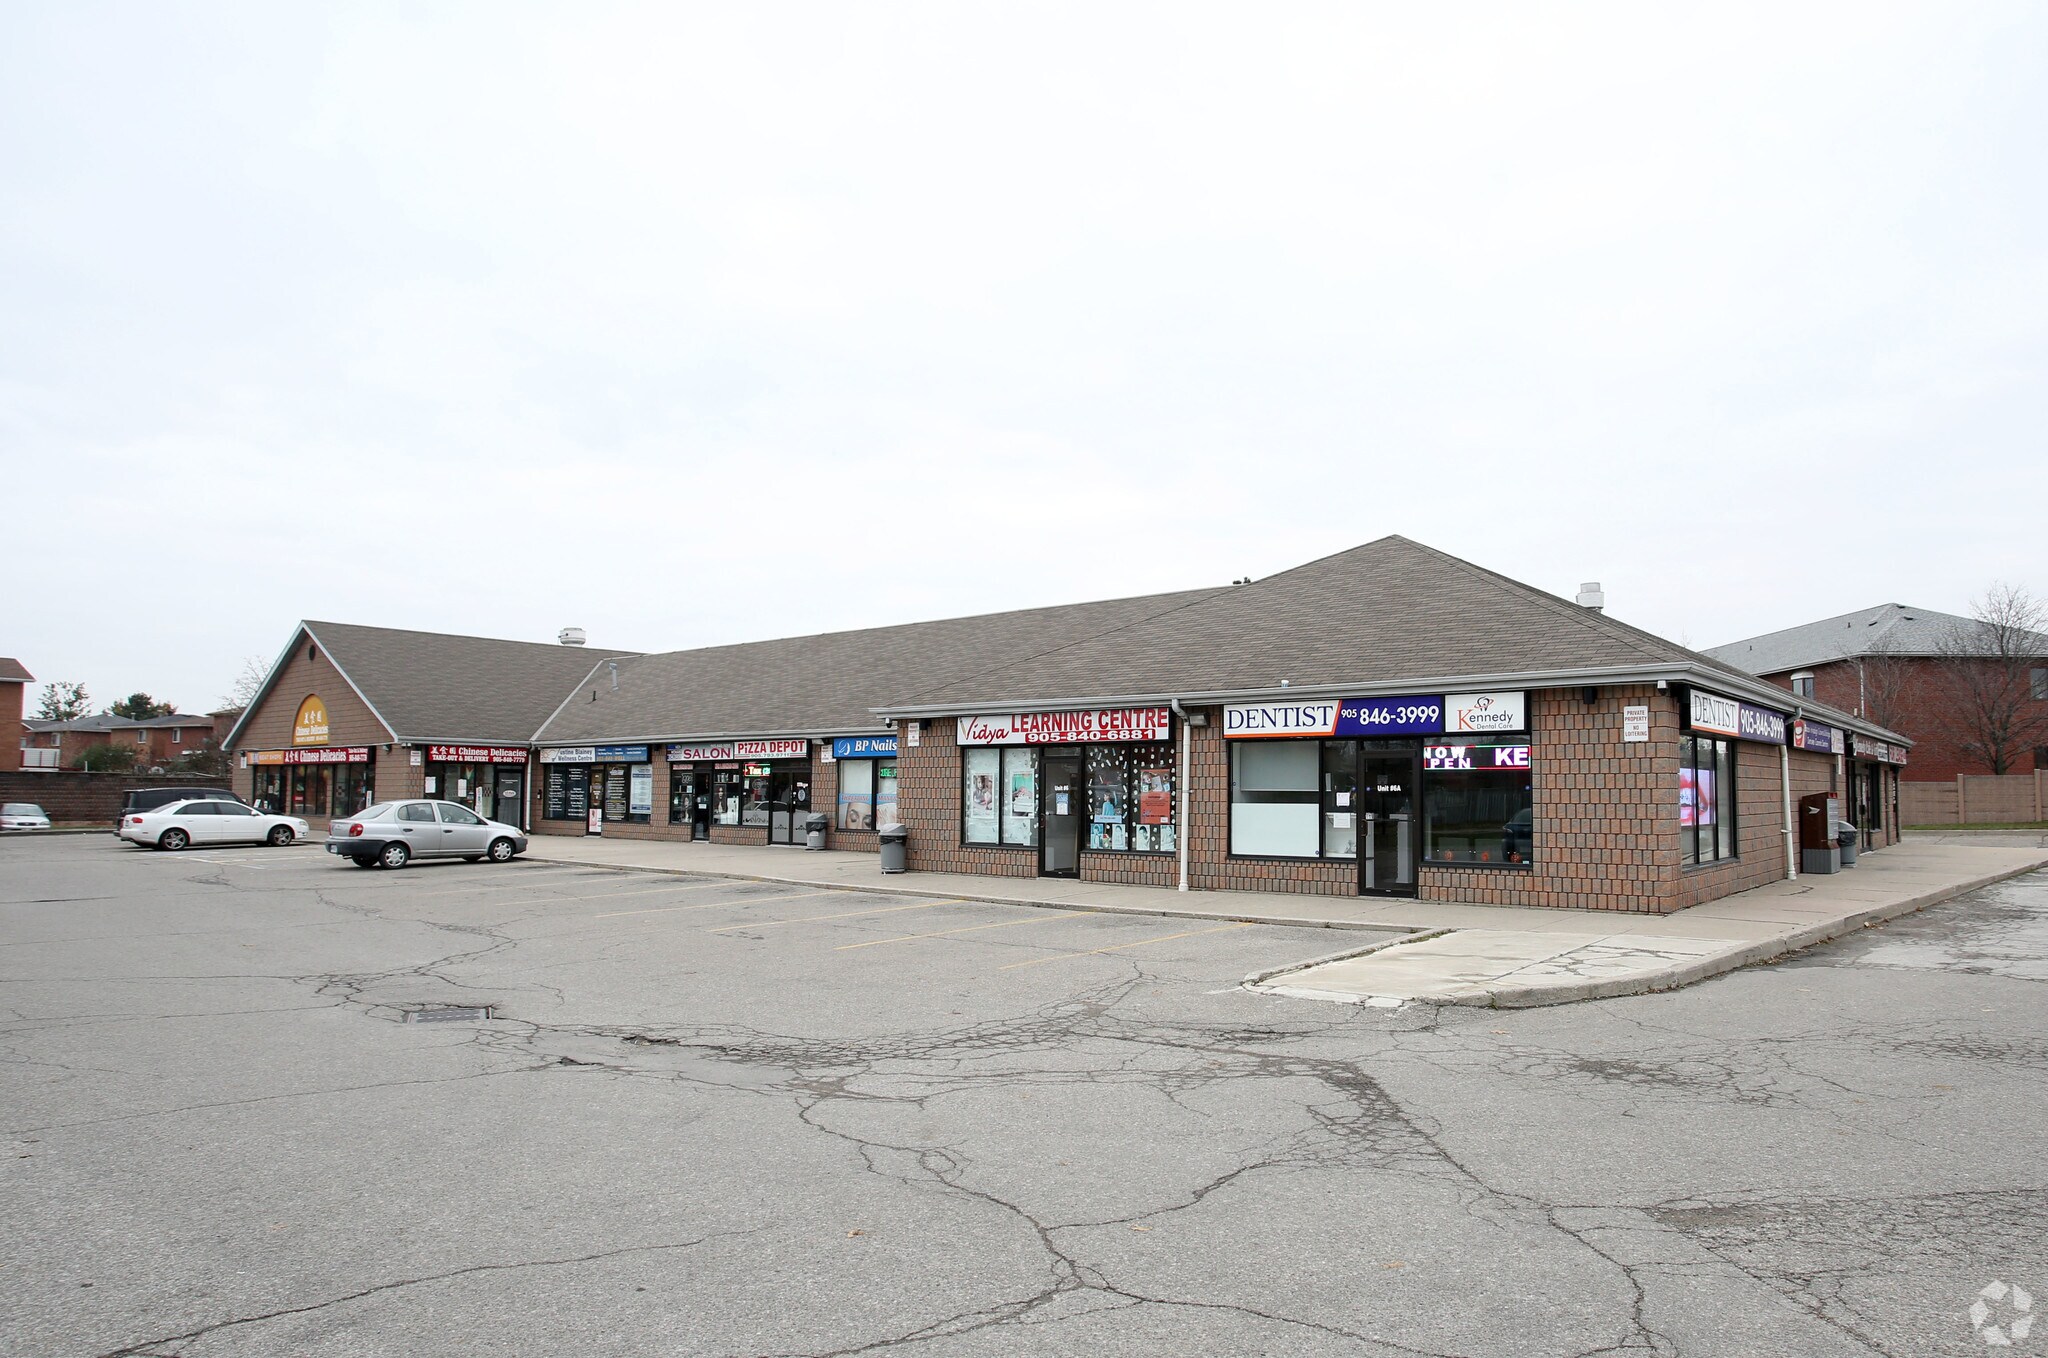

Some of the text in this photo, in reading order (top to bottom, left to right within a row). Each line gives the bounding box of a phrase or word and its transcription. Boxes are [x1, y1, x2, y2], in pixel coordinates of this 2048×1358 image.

[1011, 708, 1168, 732] LEARNING CENTRE
[1227, 705, 1333, 729] DENTIST
[1341, 705, 1440, 725] 905 846-3999
[1457, 709, 1513, 730] Kennedy
[1694, 694, 1737, 729] DENTIST
[959, 717, 1009, 744] Vidya
[1740, 708, 1784, 739] 905-846-3999
[855, 739, 897, 752] BP Nails
[1027, 730, 1155, 742] 905-840-6881
[300, 749, 346, 762] Chinese Delicacies
[459, 747, 527, 757] Chinese Delicacies
[684, 748, 730, 759] SALON
[770, 740, 805, 753] DEPOT
